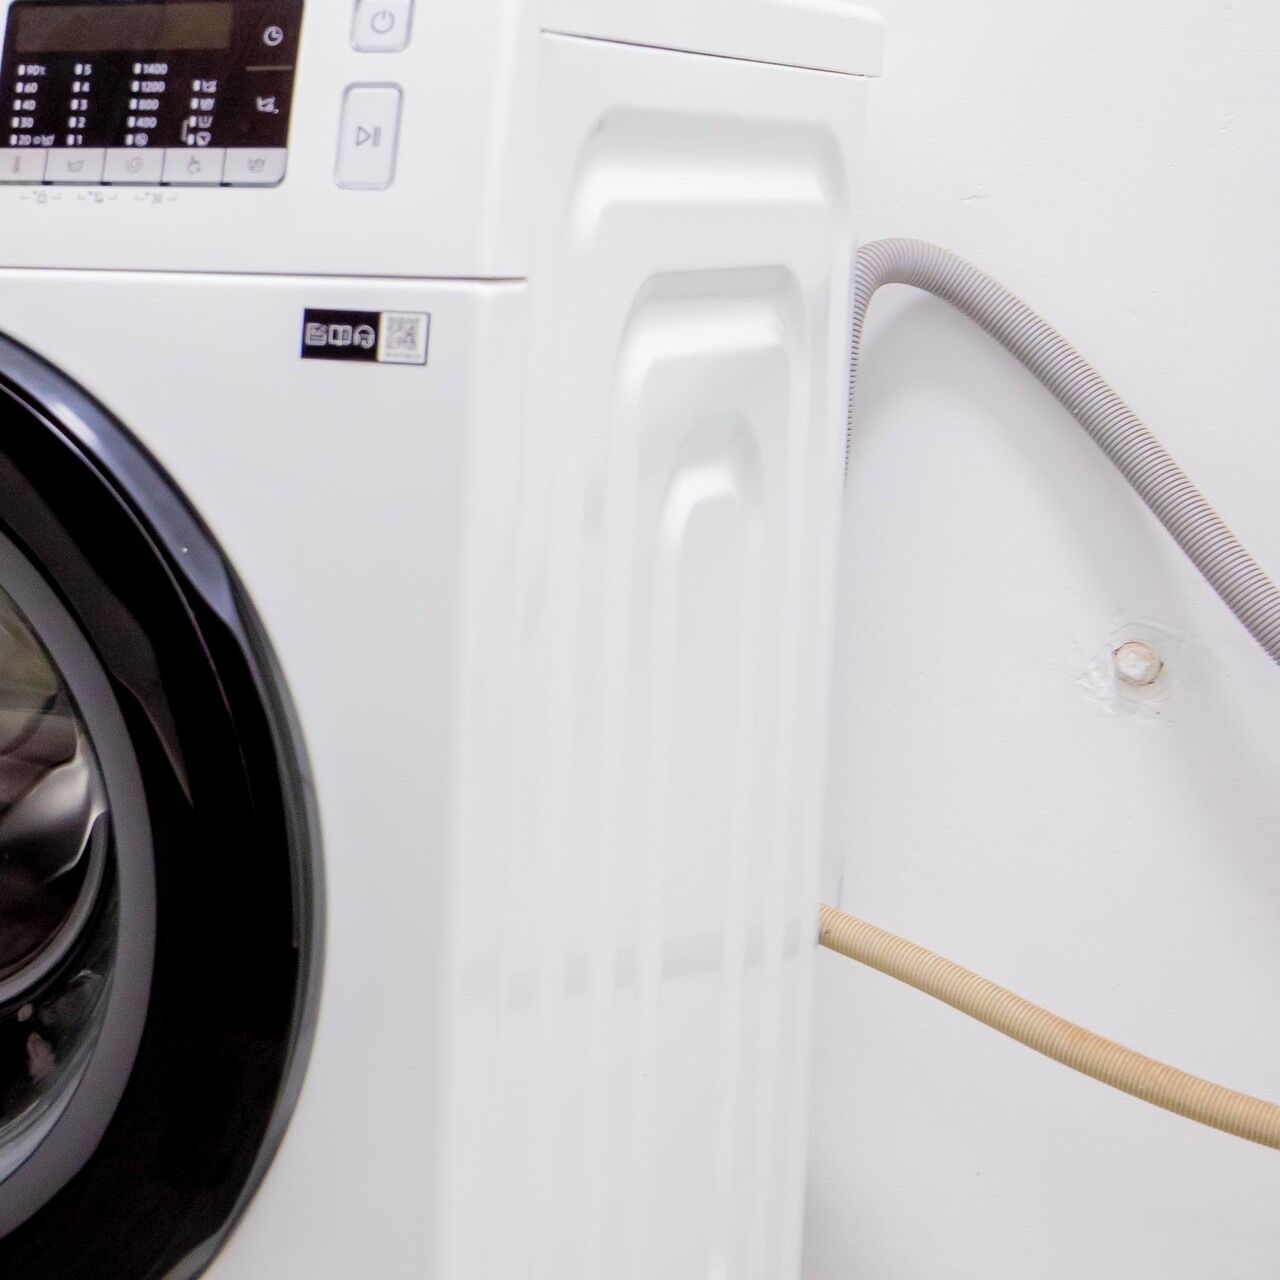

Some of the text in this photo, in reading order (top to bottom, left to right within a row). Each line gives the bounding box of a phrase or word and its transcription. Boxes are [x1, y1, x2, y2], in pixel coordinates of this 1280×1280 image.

[83, 64, 92, 75] 5
[142, 63, 168, 75] 1400
[23, 82, 38, 94] 60
[81, 81, 90, 93] 4
[141, 80, 166, 93] 1200
[22, 99, 36, 111] 40
[79, 99, 88, 111] 3
[137, 98, 159, 111] 800
[20, 116, 34, 129] 30
[77, 116, 86, 128] 2
[136, 116, 157, 128] 400
[18, 134, 32, 146] 20
[76, 134, 84, 146] 1
